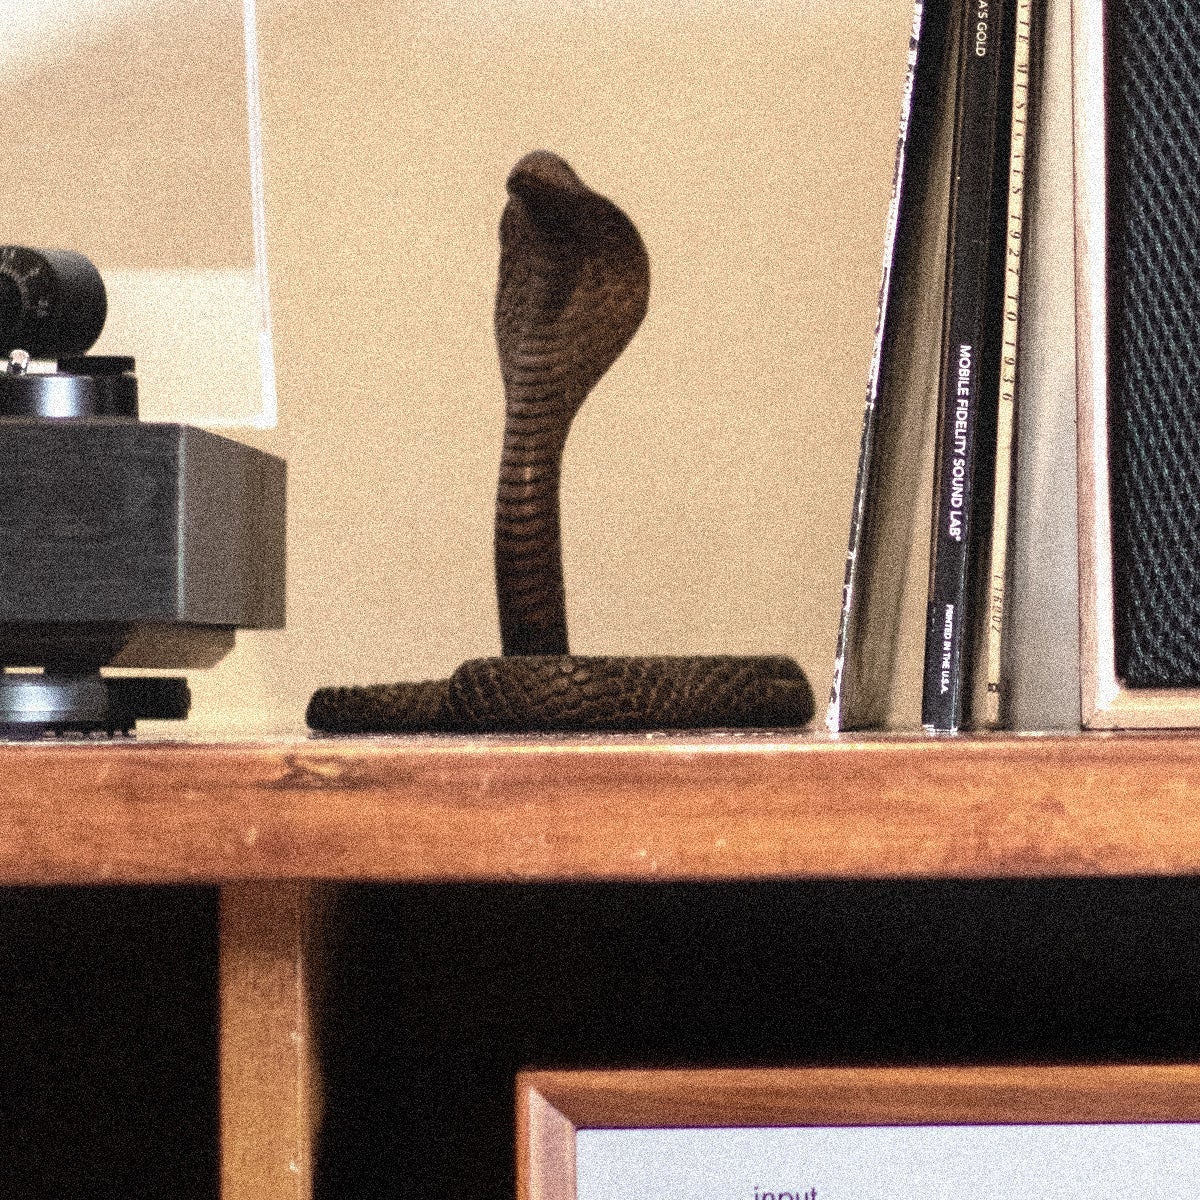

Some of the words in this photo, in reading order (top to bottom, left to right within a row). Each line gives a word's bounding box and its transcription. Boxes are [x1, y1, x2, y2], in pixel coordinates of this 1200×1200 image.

[974, 22, 988, 56] GOLD
[1007, 214, 1022, 274] 1927
[1006, 294, 1018, 322] TO
[956, 344, 972, 395] MOBILE
[1002, 340, 1016, 401] 1936
[952, 398, 969, 455] FIDELITY
[949, 458, 965, 508] SOUND
[943, 604, 954, 638] PRINTED
[941, 652, 950, 668] THE
[942, 641, 951, 650] IN
[939, 670, 949, 694] U.S.A.
